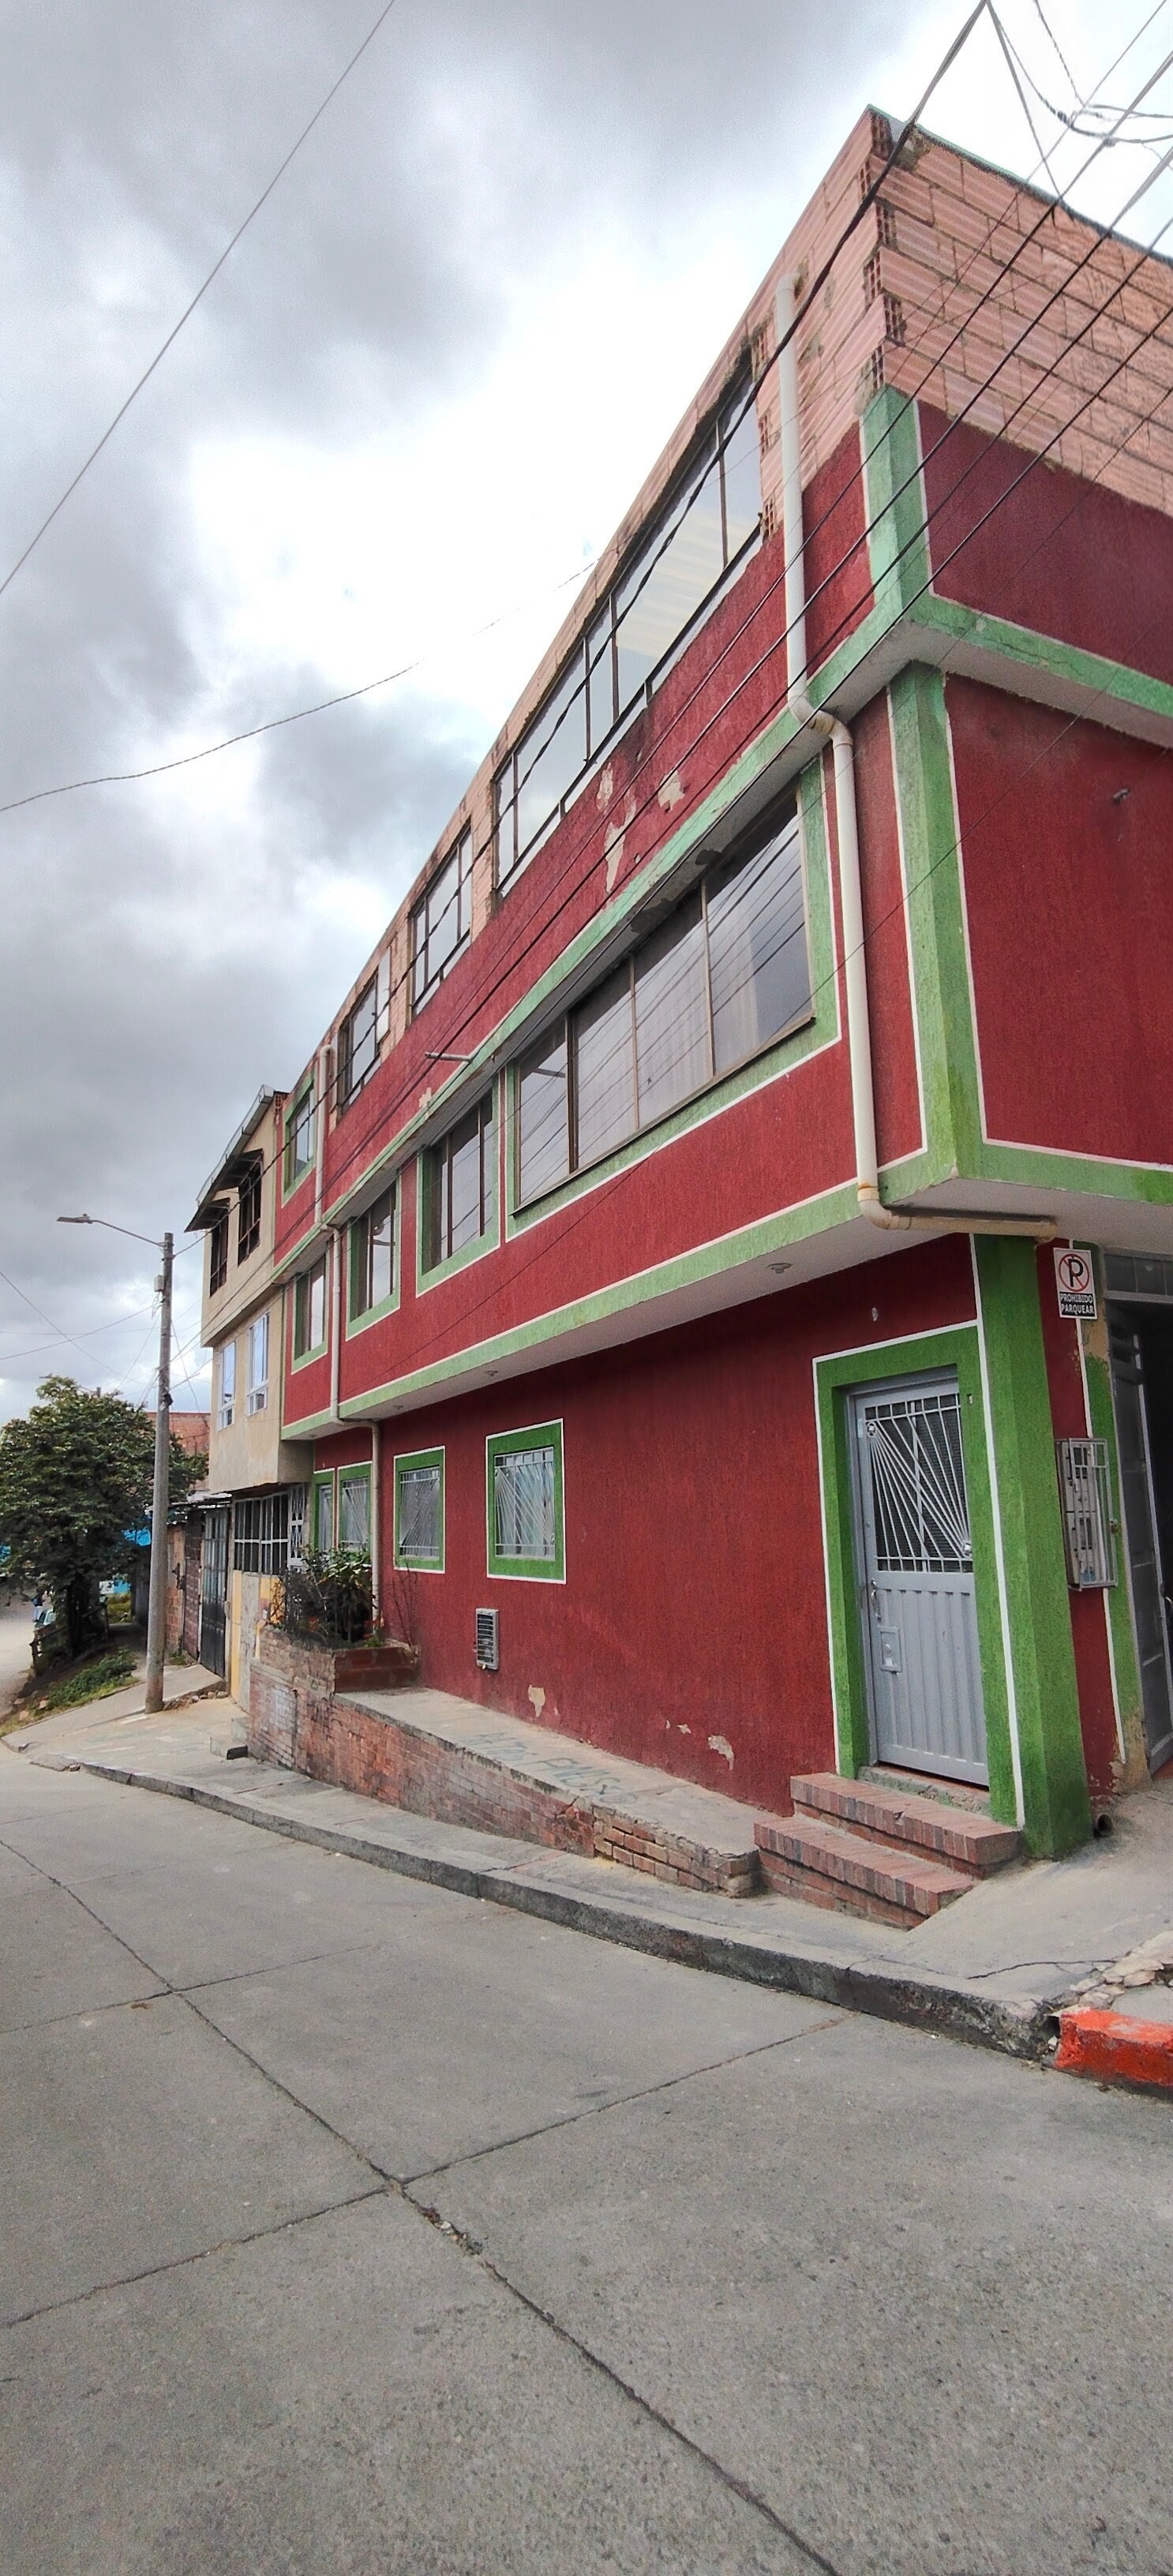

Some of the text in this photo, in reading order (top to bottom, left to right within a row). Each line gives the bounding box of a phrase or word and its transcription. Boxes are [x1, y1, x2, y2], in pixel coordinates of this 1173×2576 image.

[1068, 1258, 1083, 1287] P
[1060, 1294, 1092, 1303] PROHIBIDO
[1061, 1304, 1094, 1314] PARQUEAR
